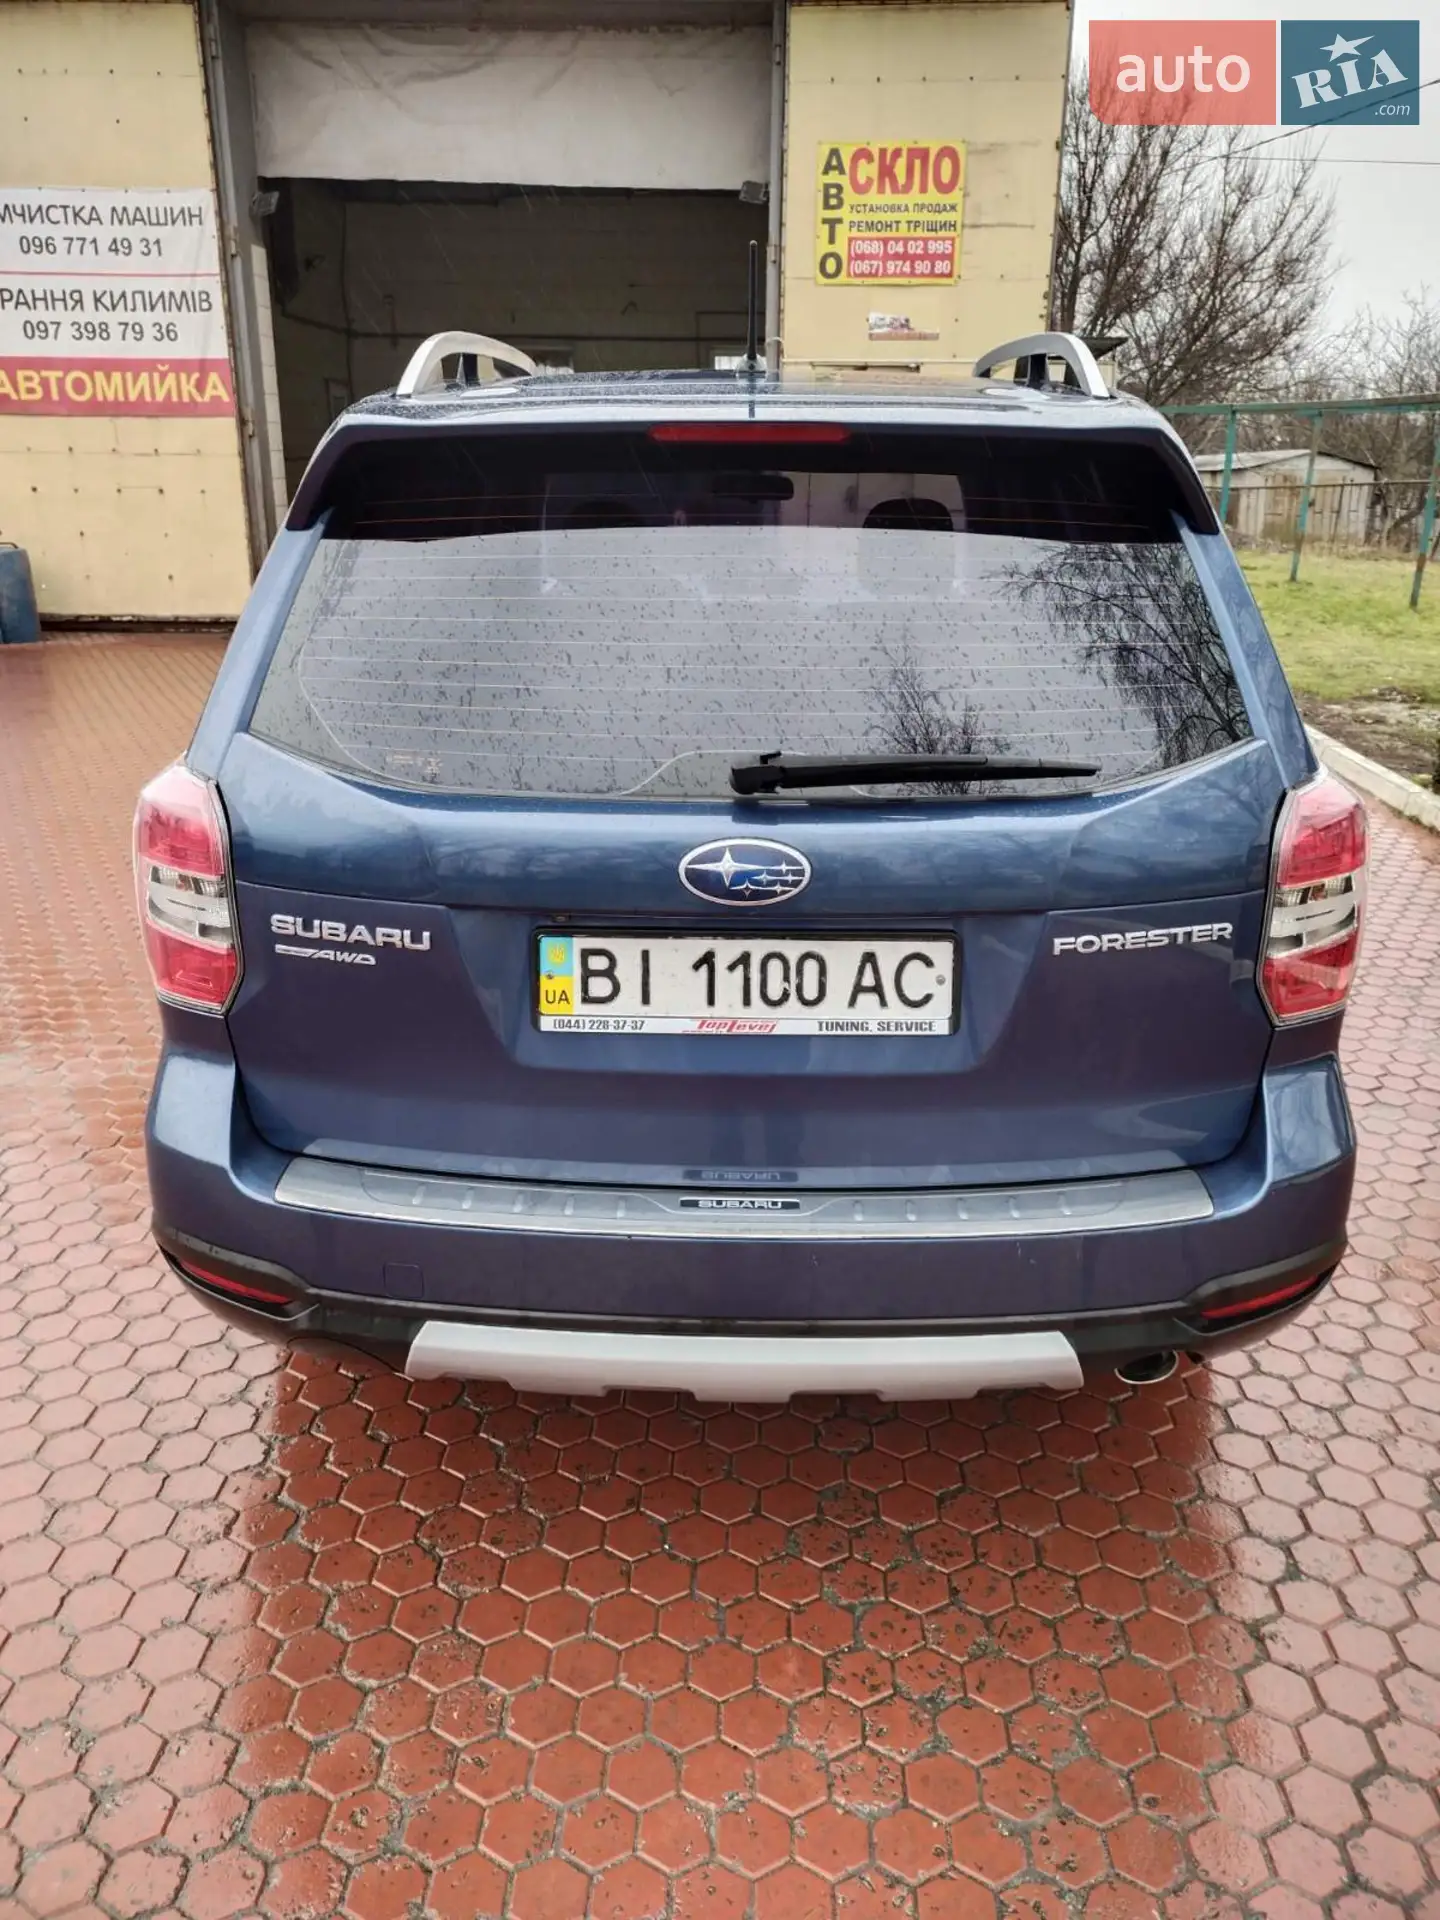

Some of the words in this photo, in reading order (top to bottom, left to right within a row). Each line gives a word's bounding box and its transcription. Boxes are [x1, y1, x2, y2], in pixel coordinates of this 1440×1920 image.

[849, 146, 961, 195] СКЛО
[110, 206, 203, 227] МАШИН
[819, 147, 847, 280] АВТО
[849, 203, 910, 214] УСТАНОВКА
[913, 203, 958, 213] ПРОДАЖ
[849, 220, 901, 232] РЕМОНТ
[907, 220, 957, 234] ТРІЩИН
[20, 235, 57, 255] 096
[63, 236, 99, 256] 771
[108, 237, 132, 256] 49
[140, 238, 162, 257] 31
[851, 240, 884, 257] (068)
[888, 241, 904, 254] 04
[908, 241, 924, 254] 02
[928, 240, 952, 254] 995
[850, 260, 883, 276] (067)
[887, 260, 910, 274] 974
[914, 260, 931, 274] 90
[934, 260, 950, 273] 80
[93, 290, 213, 313] КИЛИМІВ
[23, 320, 61, 340] 097
[70, 321, 111, 341] 398
[118, 322, 144, 341] 79
[152, 322, 179, 342] 36
[0, 364, 230, 402] АВТОМИЙКА
[270, 913, 431, 951] SUBARU
[1052, 922, 1233, 956] FORESTER
[312, 949, 377, 966] AWD
[580, 948, 651, 1006] BI
[691, 949, 828, 1008] 1100
[847, 950, 936, 1009] AC
[545, 989, 571, 1005] UA
[553, 1019, 586, 1030] (044)
[588, 1019, 645, 1031] 228-37-37
[876, 1021, 936, 1032] SERVICE
[698, 1200, 782, 1209] SUBARU
